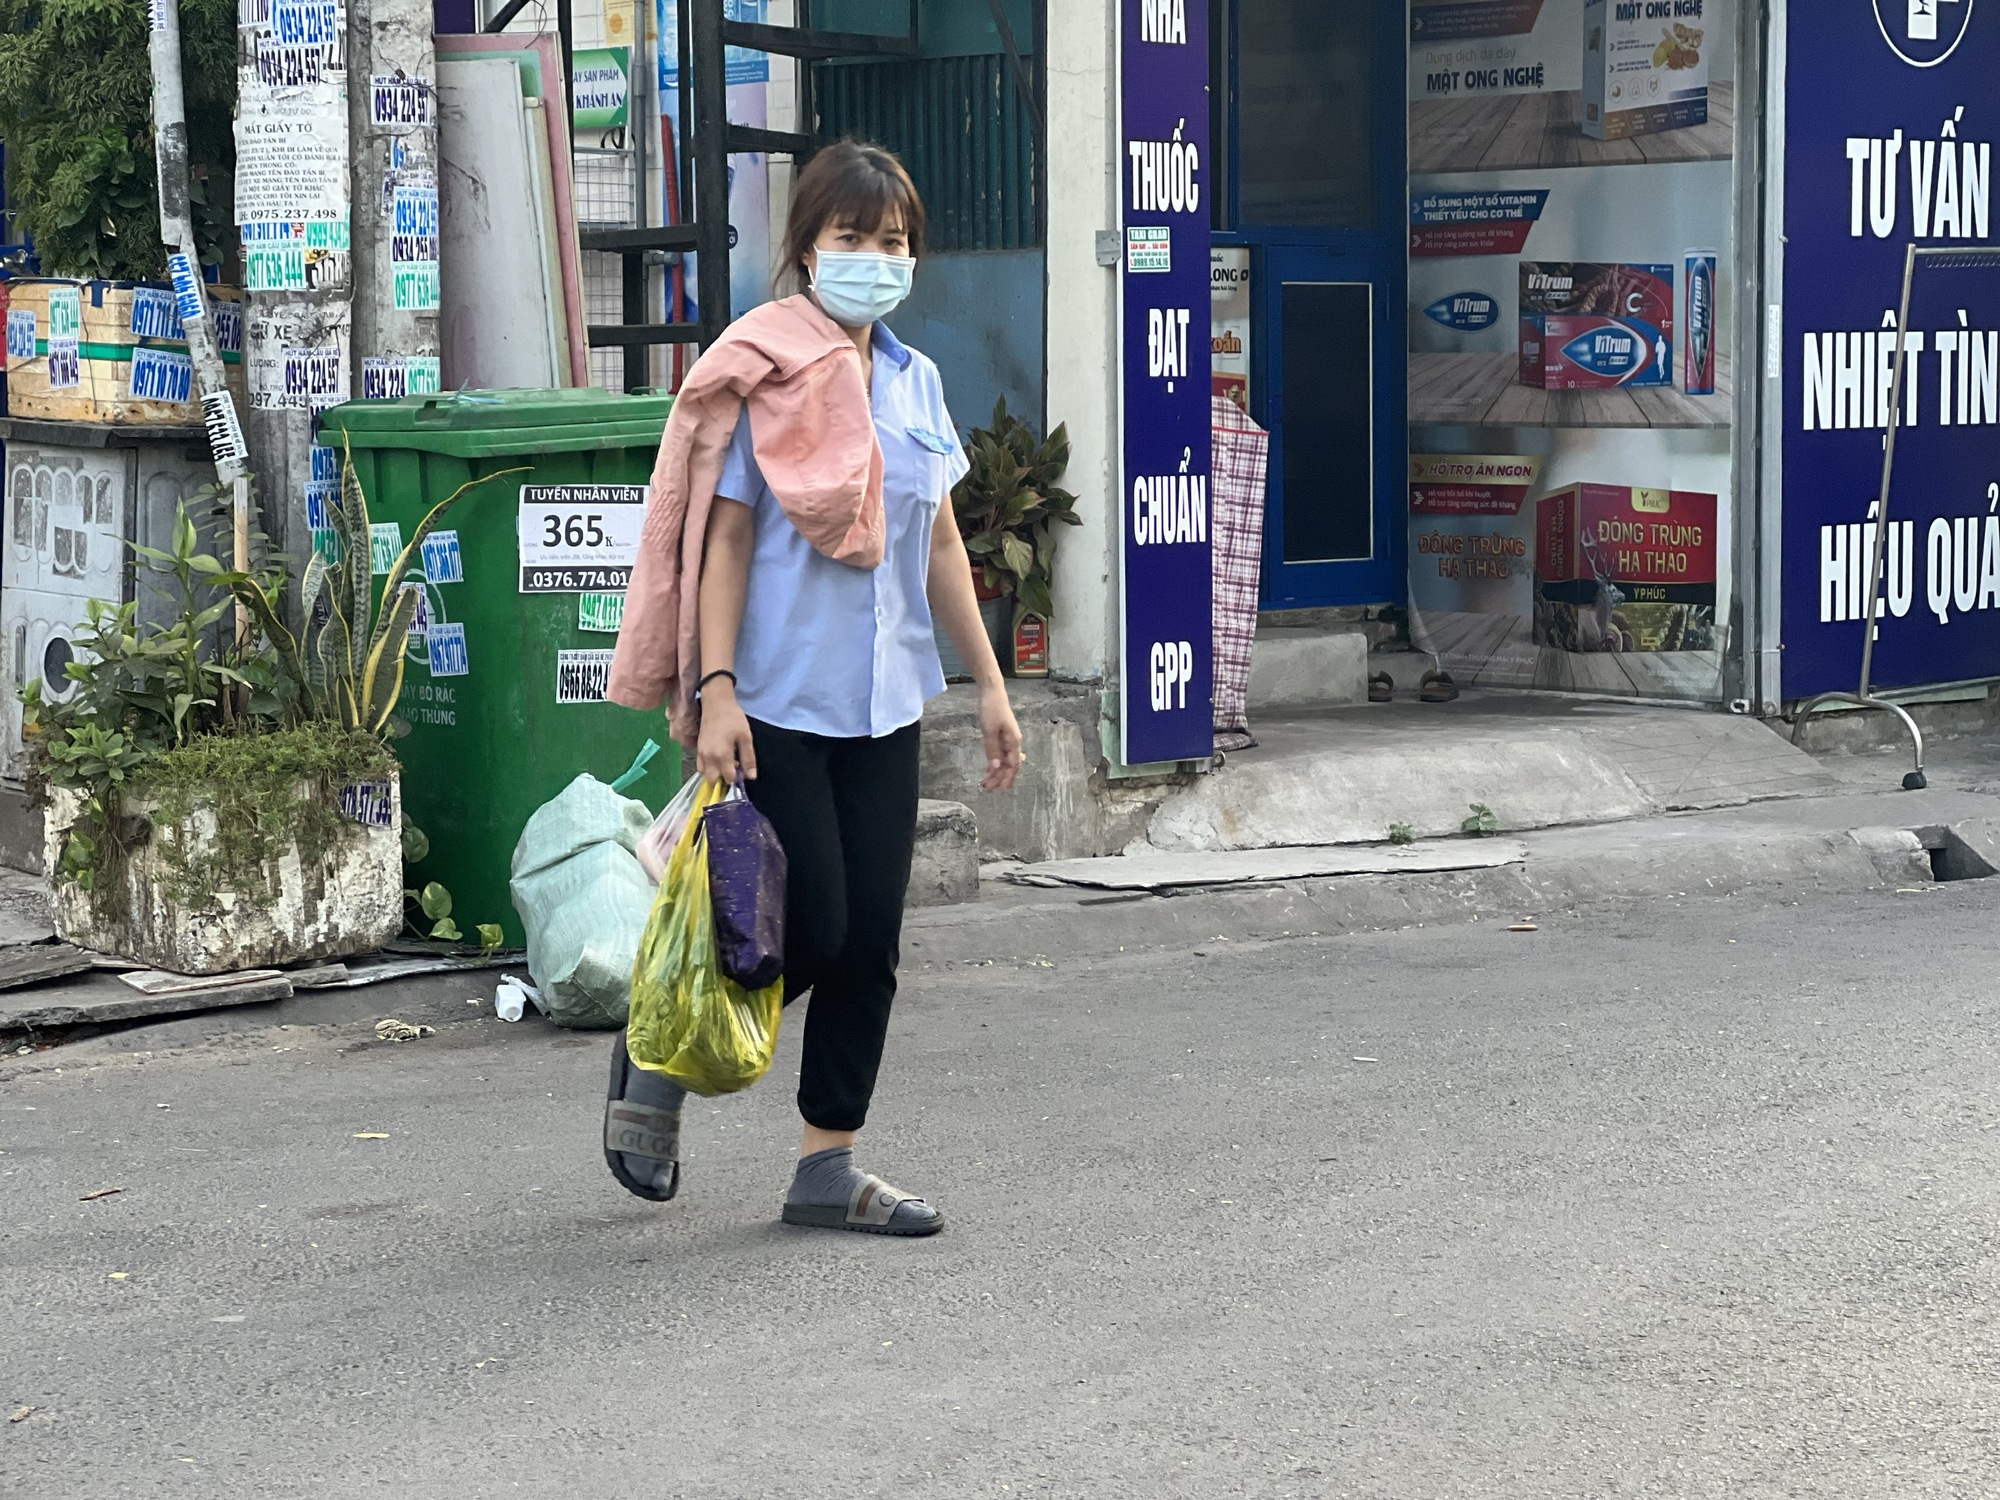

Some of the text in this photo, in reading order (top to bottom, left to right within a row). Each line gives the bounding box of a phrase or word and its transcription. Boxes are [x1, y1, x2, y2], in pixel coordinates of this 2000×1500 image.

[1645, 1, 1671, 19] ONG
[260, 48, 320, 87] 0934.224.557
[1427, 61, 1544, 94] MẬT ONG NGHỆ
[576, 84, 623, 109] KHÁNH AN
[1129, 118, 1199, 212] THUỐC
[1846, 105, 1990, 238] TƯ VẤN
[250, 209, 337, 219] 0975.237.498
[1424, 207, 1449, 221] THIẾT
[1450, 206, 1468, 220] YẾU
[1469, 211, 1489, 219] CHO
[1438, 199, 1462, 207] SUNG
[1500, 195, 1537, 205] VITAMIN
[1130, 230, 1167, 240] TAXI GRAB
[1211, 268, 1237, 282] ONG
[1148, 308, 1190, 393] ĐẠT
[1803, 309, 1924, 450] NHIỆT
[1935, 309, 2000, 426] TÌN
[1475, 463, 1494, 475] ĂN
[1496, 465, 1532, 476] NGON
[530, 486, 639, 501] TUYỂN NHÂN VIÊN
[1134, 446, 1207, 545] CHUẨN
[542, 514, 604, 548] 365
[1418, 529, 1526, 557] ĐÔNG TRÙNG
[1598, 515, 1702, 548] ĐÔNG TRÙNG
[1619, 547, 1687, 577] HẠ THẢO
[1821, 482, 2000, 641] HIỆU QUẢ
[533, 571, 628, 588] 0376.774.01
[1150, 641, 1193, 711] GPP
[435, 682, 456, 703] RÁC
[420, 704, 456, 726] THÙNG
